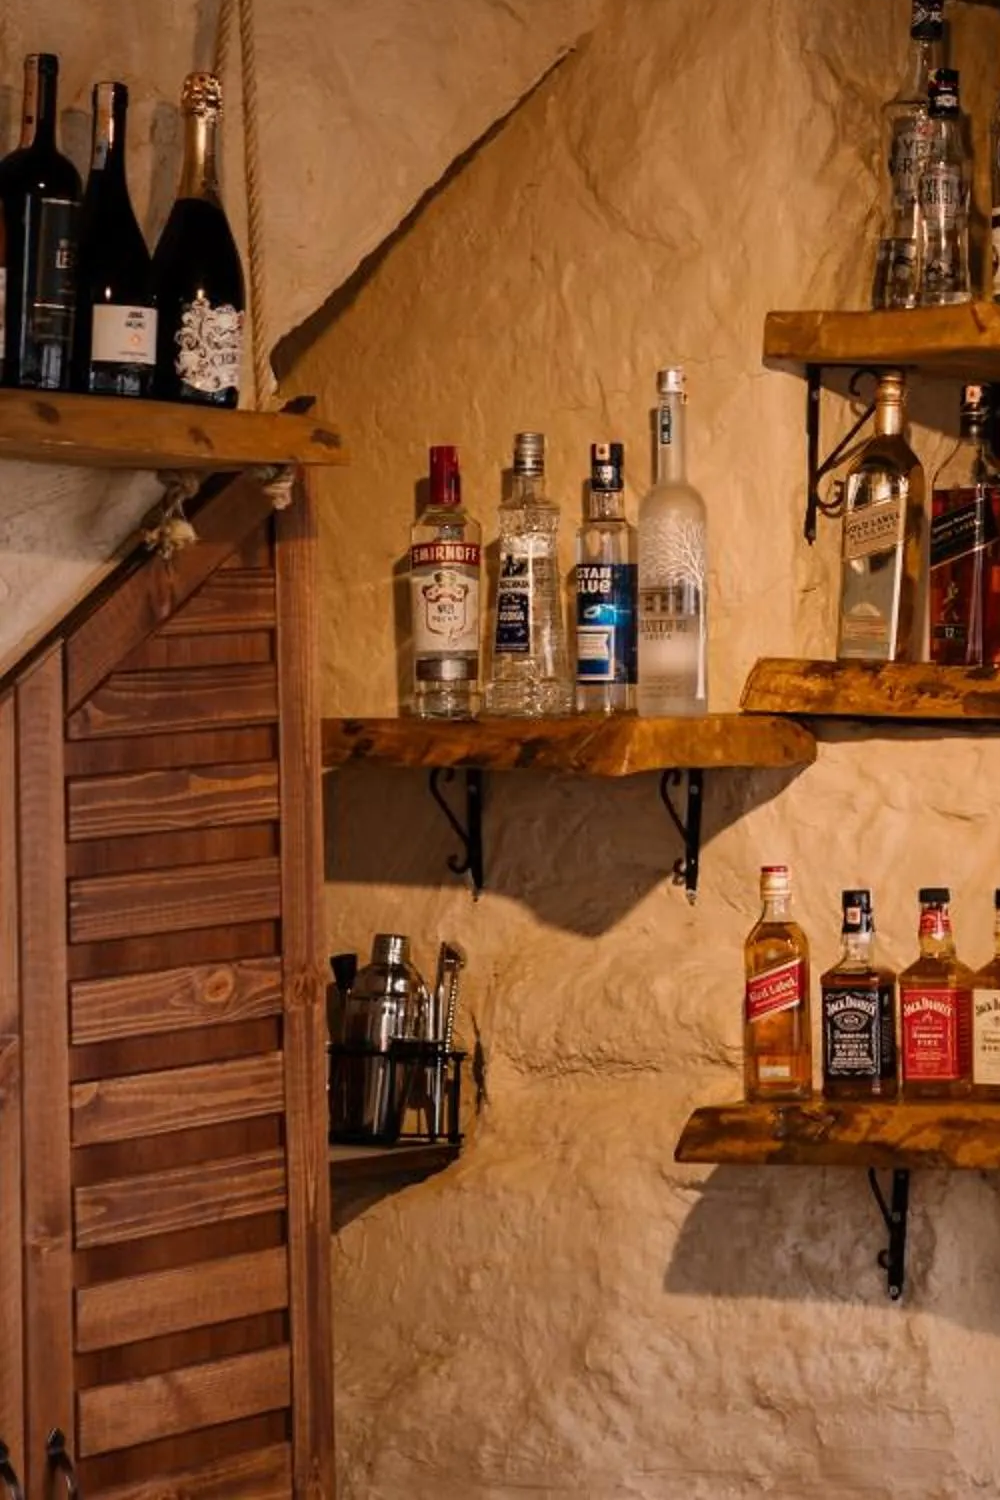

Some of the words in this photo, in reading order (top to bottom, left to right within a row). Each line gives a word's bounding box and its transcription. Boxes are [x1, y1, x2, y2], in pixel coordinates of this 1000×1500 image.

[413, 546, 478, 563] SMIRNOFF
[826, 999, 845, 1017] JACK
[904, 1001, 921, 1017] JACK
[975, 1002, 992, 1017] JACK
